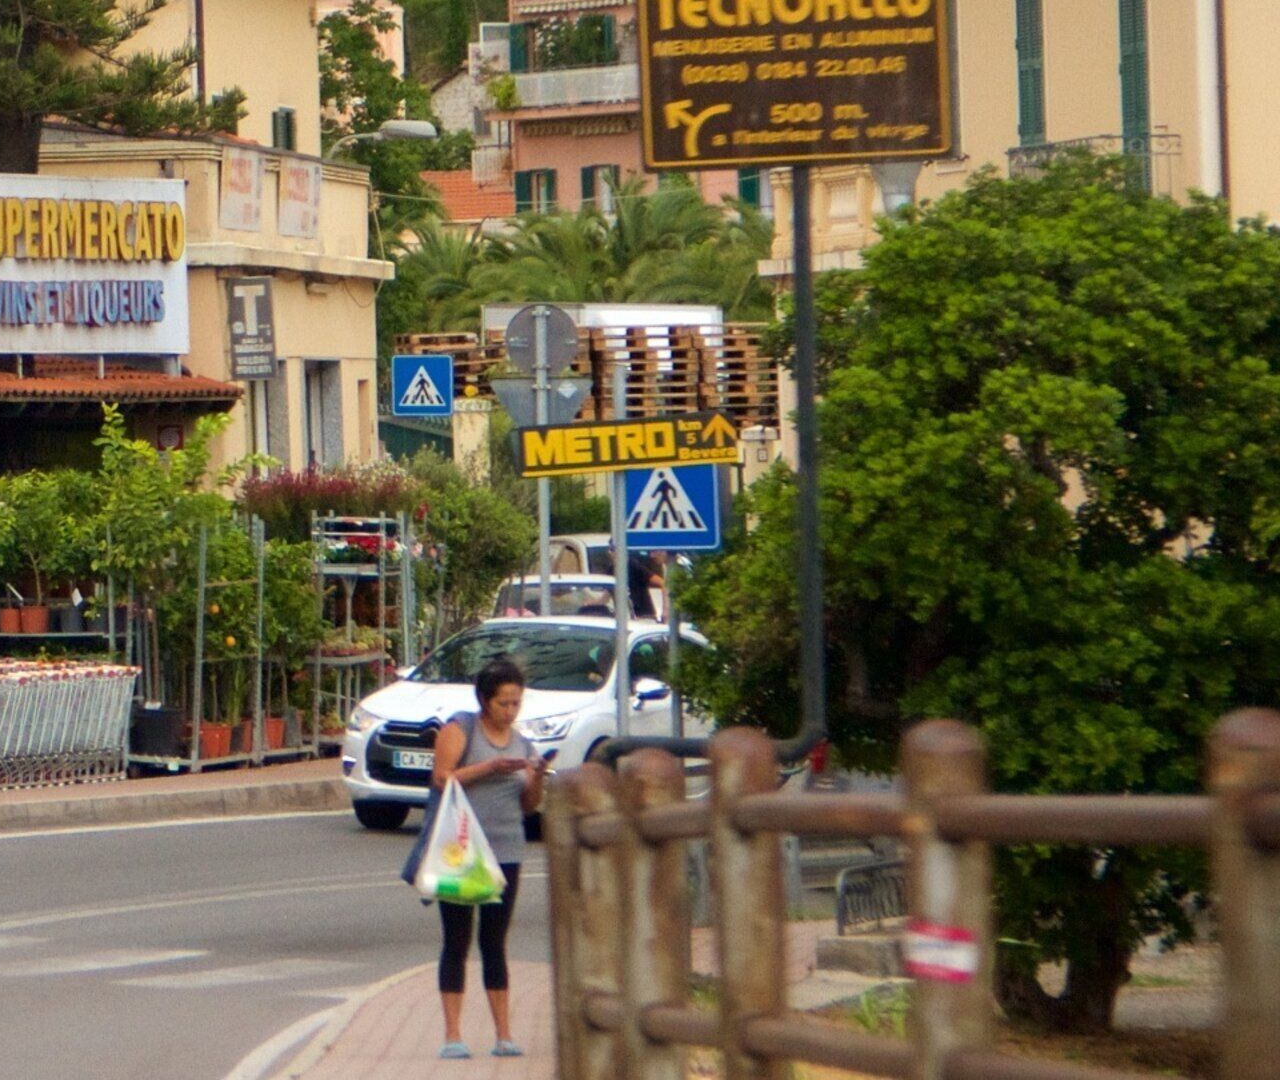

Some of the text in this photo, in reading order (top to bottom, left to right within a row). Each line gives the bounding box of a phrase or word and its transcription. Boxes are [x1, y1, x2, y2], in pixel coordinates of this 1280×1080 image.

[781, 32, 814, 51] EN
[770, 102, 823, 124] 500
[46, 280, 67, 324] ET
[72, 280, 166, 326] LIQUEURS
[523, 422, 676, 466] METRO
[678, 446, 738, 460] Bevera
